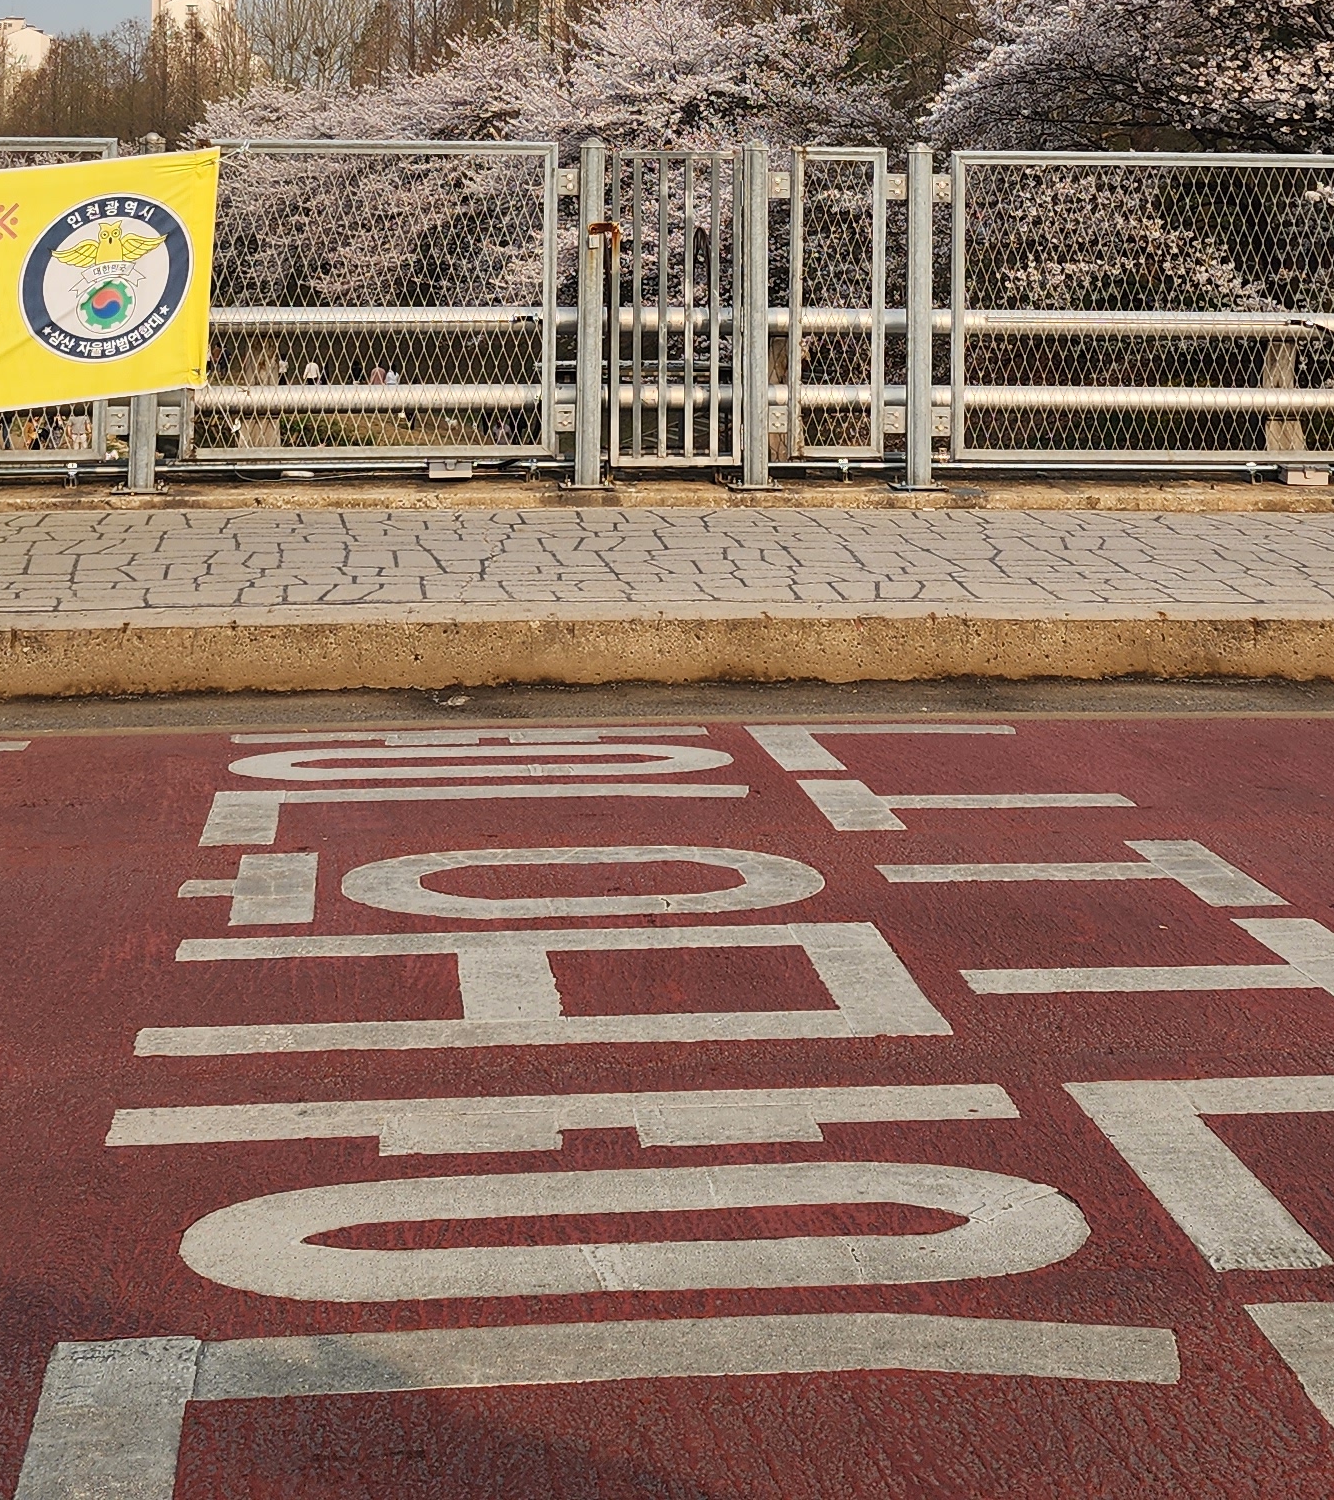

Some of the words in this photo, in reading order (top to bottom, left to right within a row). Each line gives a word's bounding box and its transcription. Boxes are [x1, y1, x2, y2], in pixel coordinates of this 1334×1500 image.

[66, 200, 155, 229] 인천광역시
[92, 263, 129, 276] 대한민국
[48, 329, 75, 352] 삼산
[76, 309, 164, 357] 자율방범연합대
